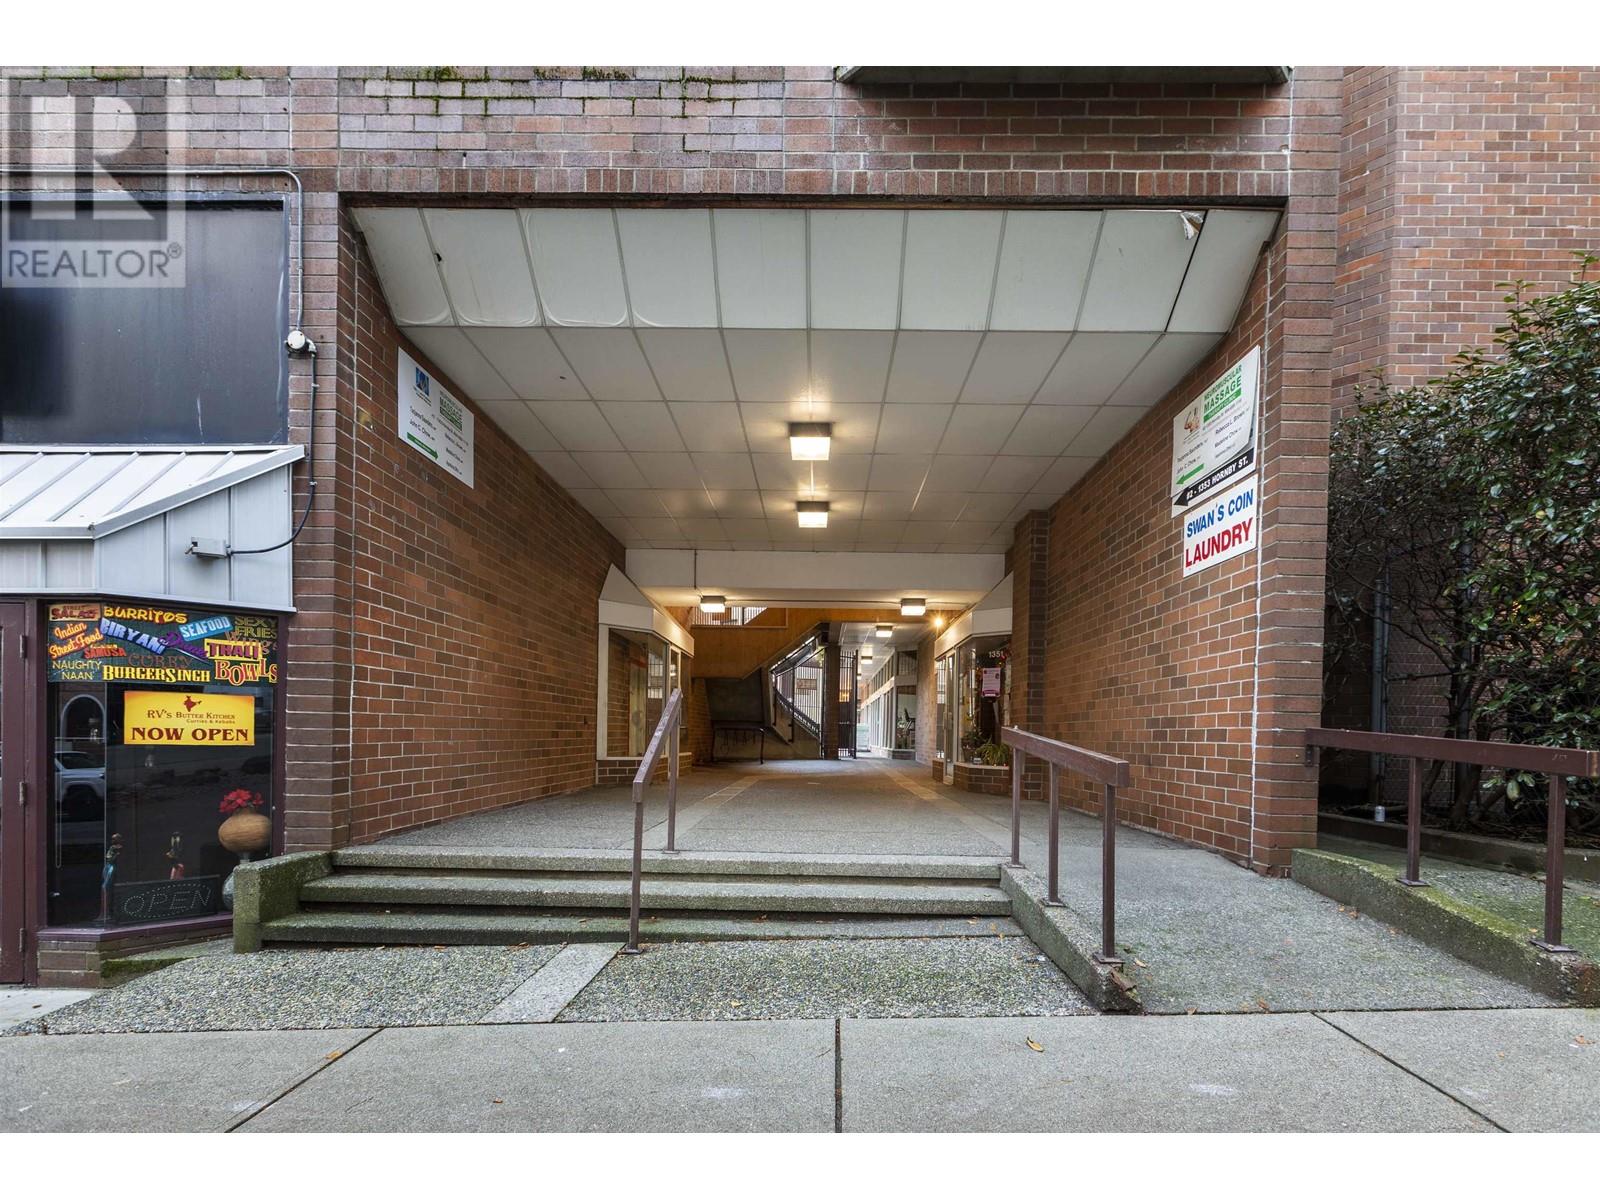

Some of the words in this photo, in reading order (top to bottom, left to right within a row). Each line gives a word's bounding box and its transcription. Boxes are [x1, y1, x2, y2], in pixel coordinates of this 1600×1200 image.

[1204, 375, 1242, 412] MASSAGE
[1211, 462, 1237, 485] HORNBY
[1238, 456, 1248, 468] ST.
[1186, 503, 1224, 538] SWAN'S
[1228, 488, 1253, 516] COIN
[1185, 517, 1253, 568] LAUNDRY
[54, 622, 87, 639] Indian
[180, 616, 231, 639] SEAFOOD
[235, 616, 278, 628] SEXY
[235, 626, 278, 639] FRIES
[49, 639, 77, 659] Street
[75, 628, 103, 648] Food
[100, 617, 166, 655] BIRYANI
[52, 660, 102, 670] NAUGHTY
[62, 671, 93, 680] NAAN
[214, 658, 278, 686] BOWLS
[131, 727, 184, 741] NOW
[191, 728, 248, 741] OPEN
[123, 888, 211, 915] OPEN
